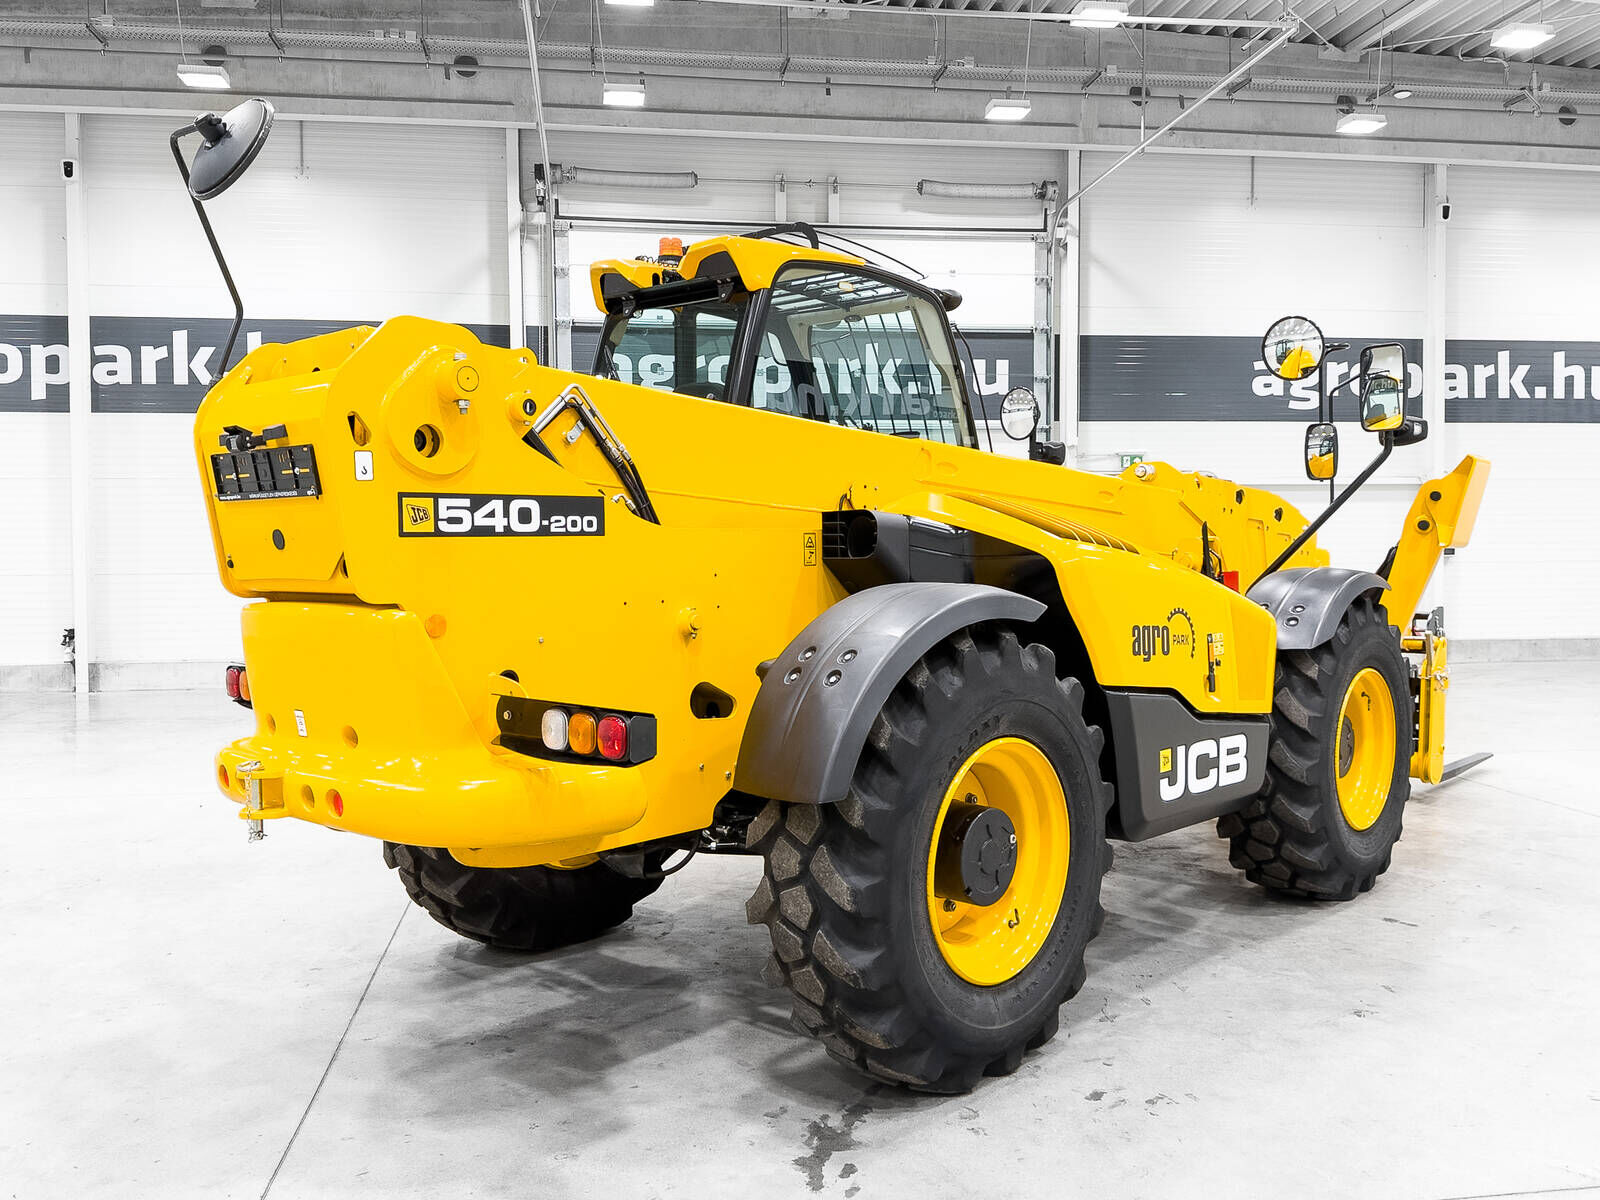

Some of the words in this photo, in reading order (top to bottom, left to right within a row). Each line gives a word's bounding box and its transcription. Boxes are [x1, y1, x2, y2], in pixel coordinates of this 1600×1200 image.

[613, 342, 1009, 409] goprk.u
[1251, 350, 1600, 411] agrark.h
[407, 504, 430, 525] JCB
[437, 498, 598, 533] 540-200
[1132, 624, 1170, 662] agro
[1172, 634, 1190, 646] PARK
[1159, 733, 1247, 802] JCB
